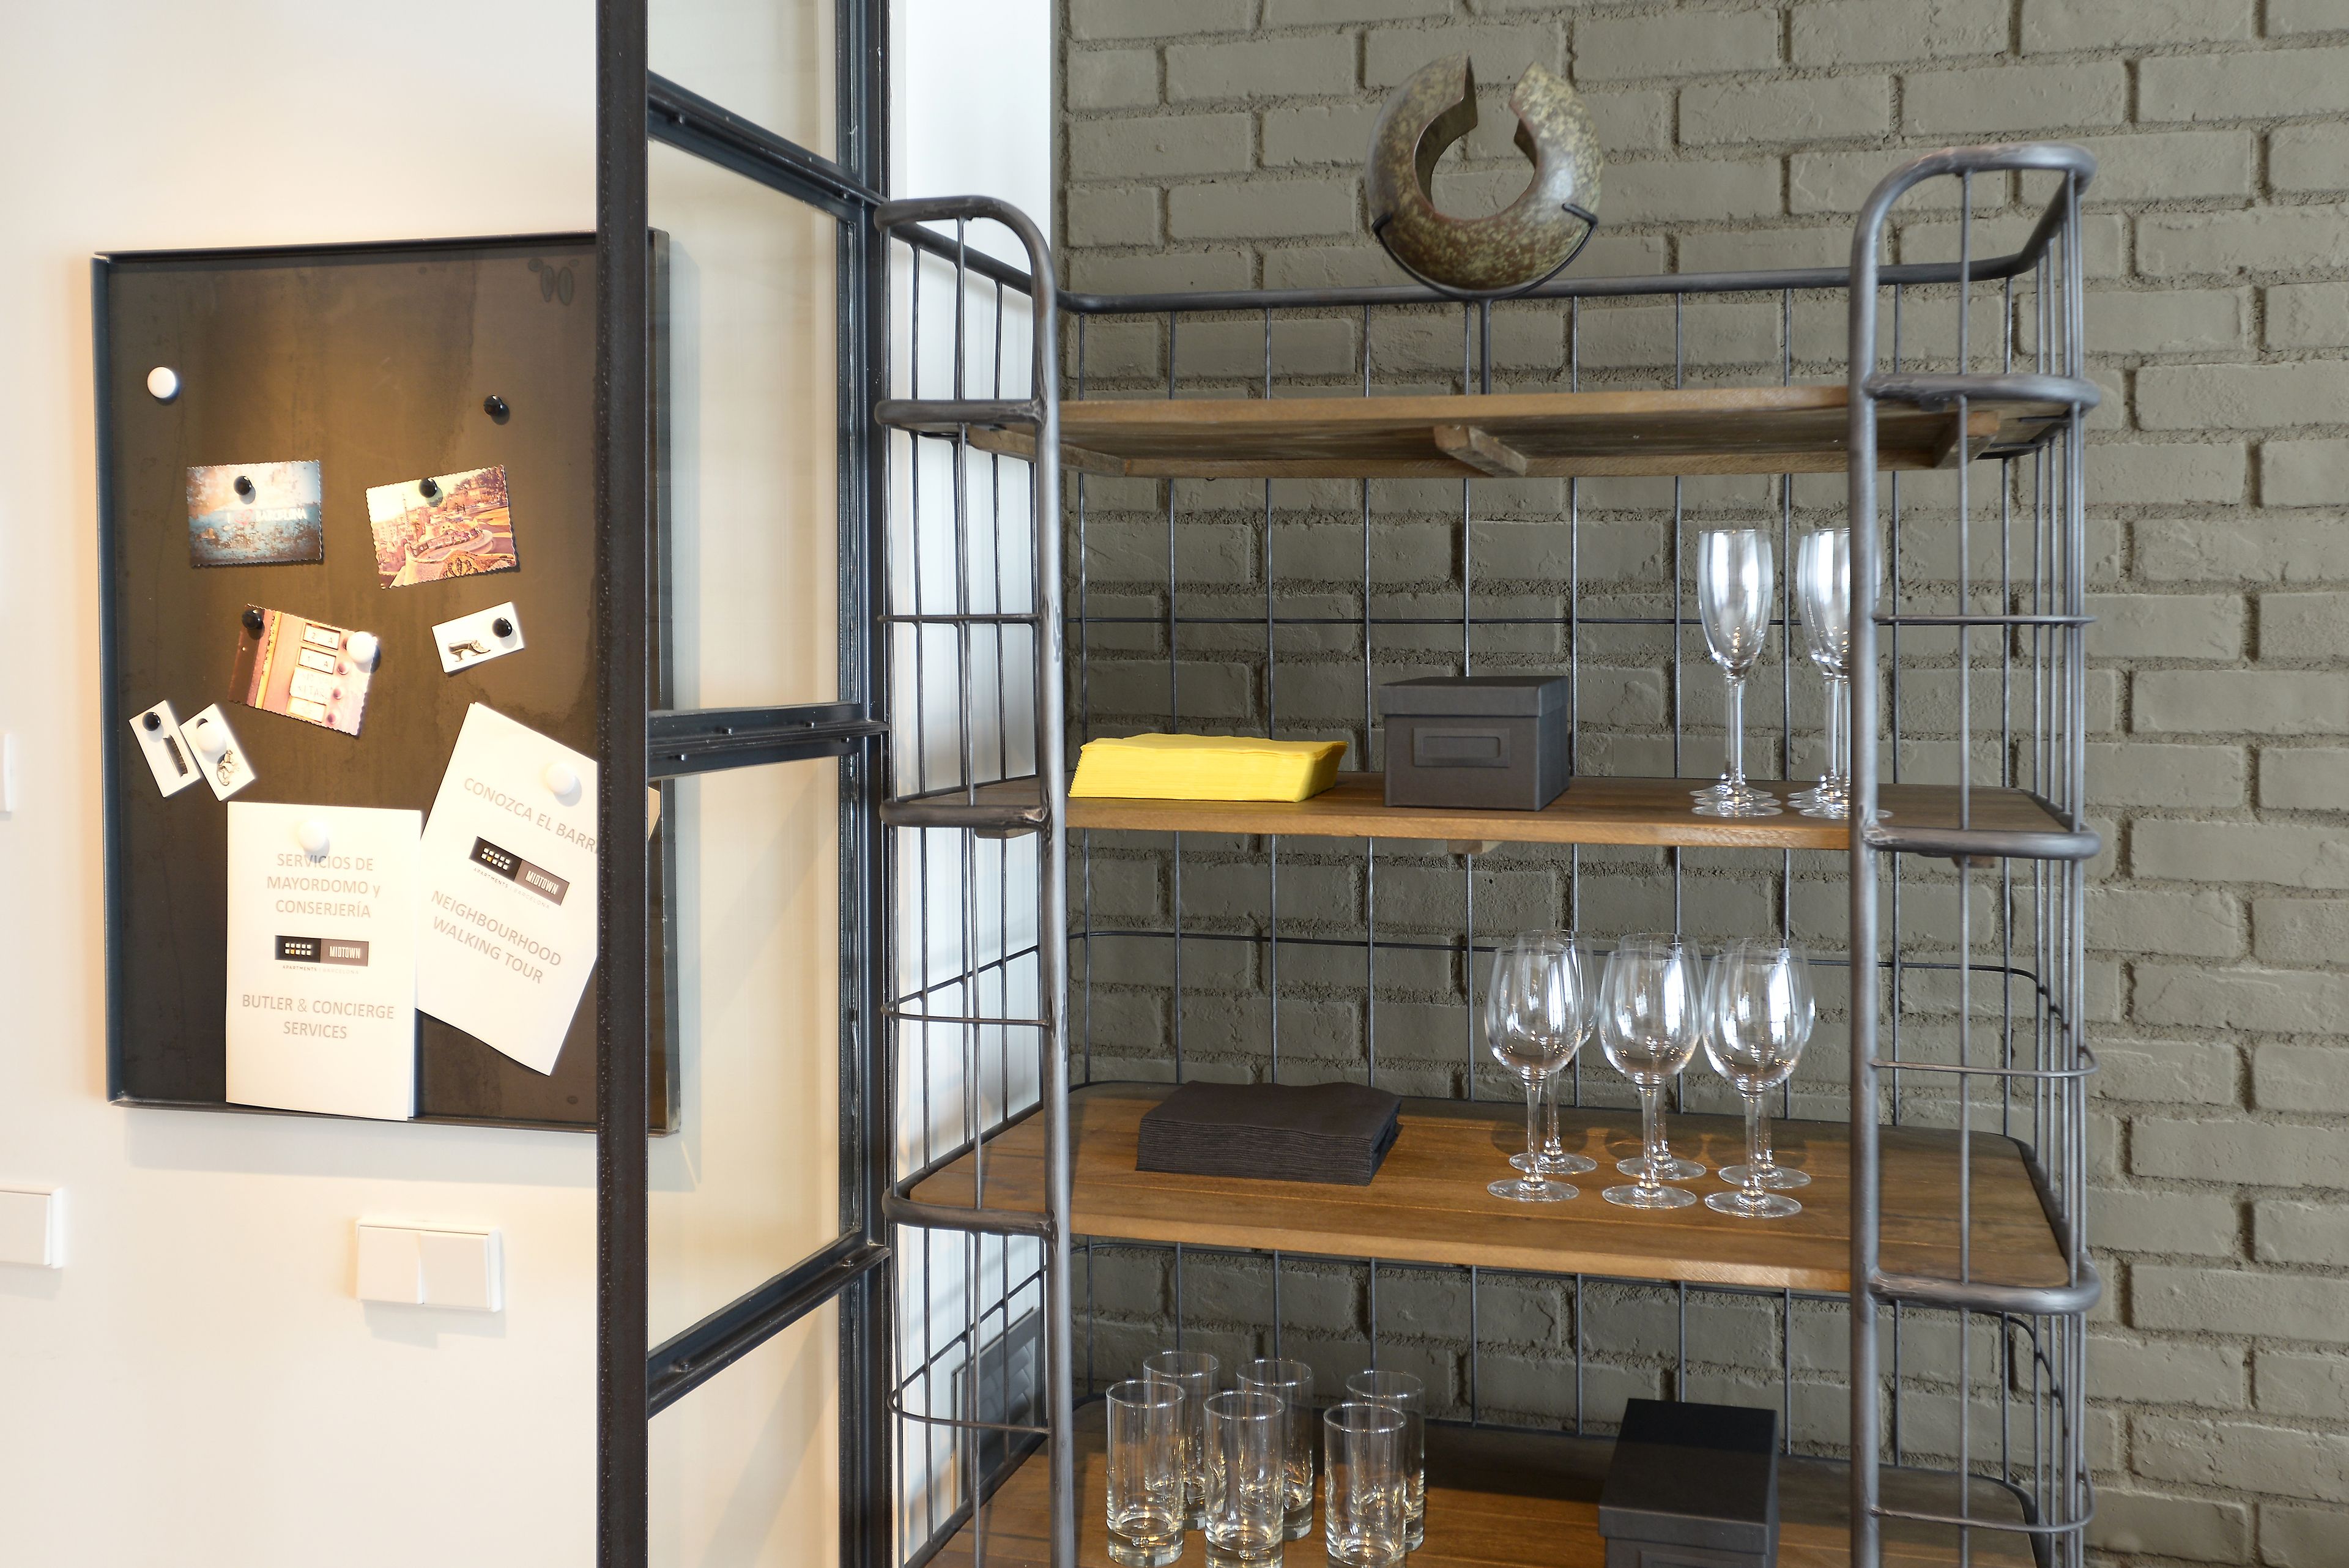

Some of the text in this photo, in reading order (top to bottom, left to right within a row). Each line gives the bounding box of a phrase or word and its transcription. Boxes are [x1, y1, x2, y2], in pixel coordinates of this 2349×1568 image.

[464, 777, 597, 854] CONOZCA EL BARR
[276, 853, 374, 871] SERVICIOS DE
[267, 875, 368, 894] MAYORDOMO
[473, 867, 550, 909] APARTMENTS BARCELONA
[524, 870, 559, 895] MIDTOWN
[276, 899, 371, 918] CONSERJERÍA
[431, 890, 562, 966] NEIGHBOURHOOD
[328, 946, 360, 959] MIDTOWN
[433, 916, 543, 984] WALKING TOUR
[242, 994, 395, 1019] BUTLER & CONCIERGE
[283, 1021, 347, 1039] SERVICES
